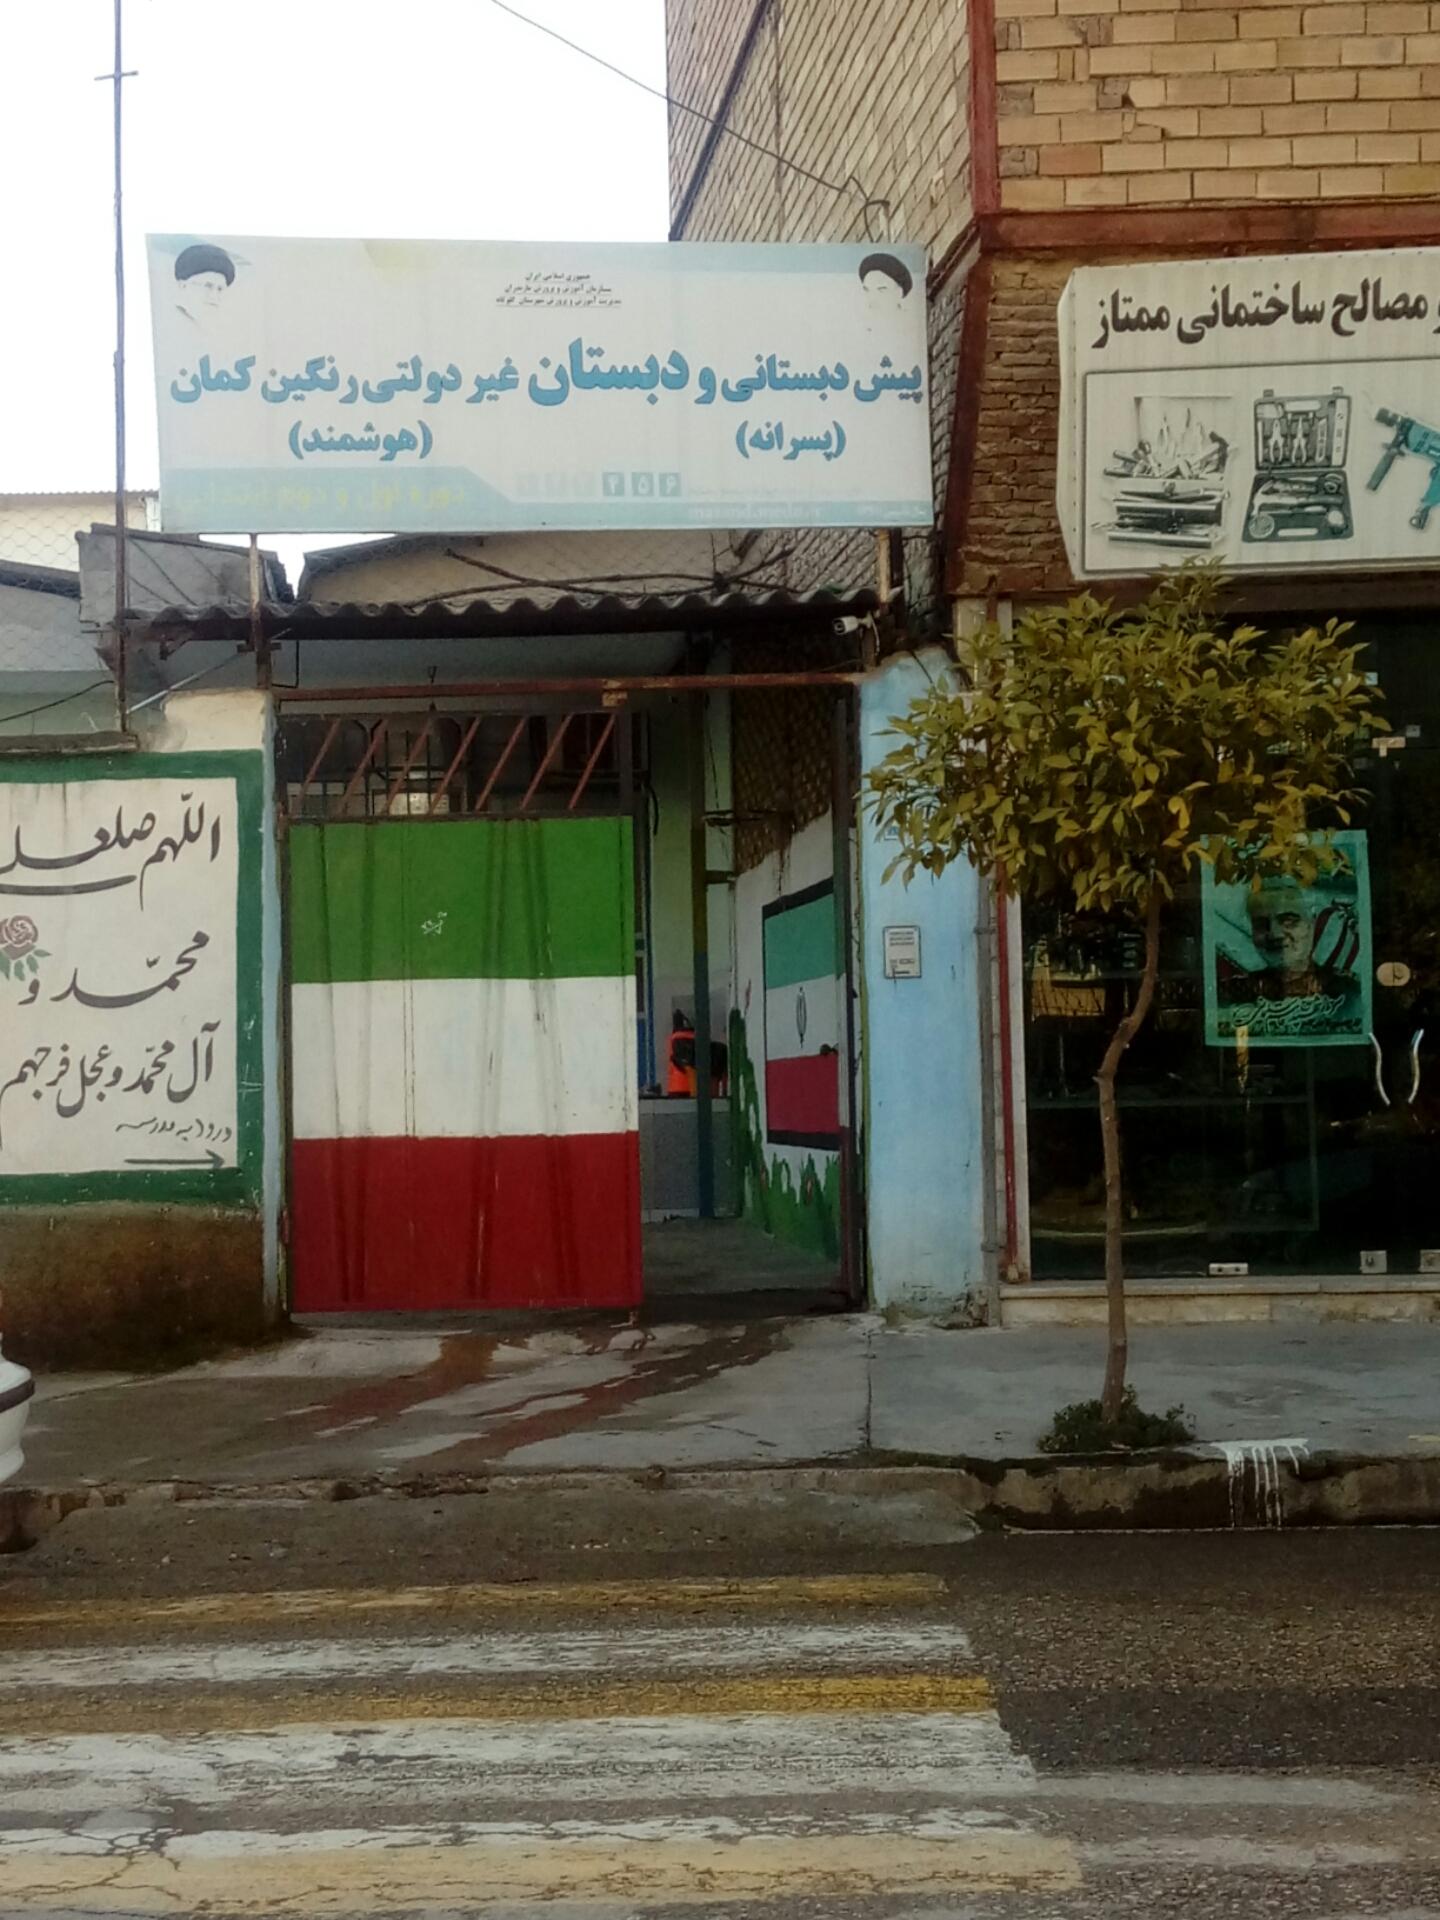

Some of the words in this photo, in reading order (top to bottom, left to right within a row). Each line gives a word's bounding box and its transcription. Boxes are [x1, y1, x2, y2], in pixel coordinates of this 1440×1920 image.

[1091, 288, 1171, 349] ممتاز
[1178, 280, 1325, 344] ساختمانی
[1331, 276, 1428, 337] مصالح
[170, 354, 256, 403] کمان
[260, 355, 359, 403] رنگین
[362, 355, 462, 403] دولتی
[465, 357, 519, 402] غیر
[528, 337, 691, 406] دبستان
[694, 365, 717, 404] و
[721, 353, 850, 402] دبستانی
[853, 355, 924, 402] پیش
[18, 978, 40, 1005] و
[166, 1020, 221, 1103] آل
